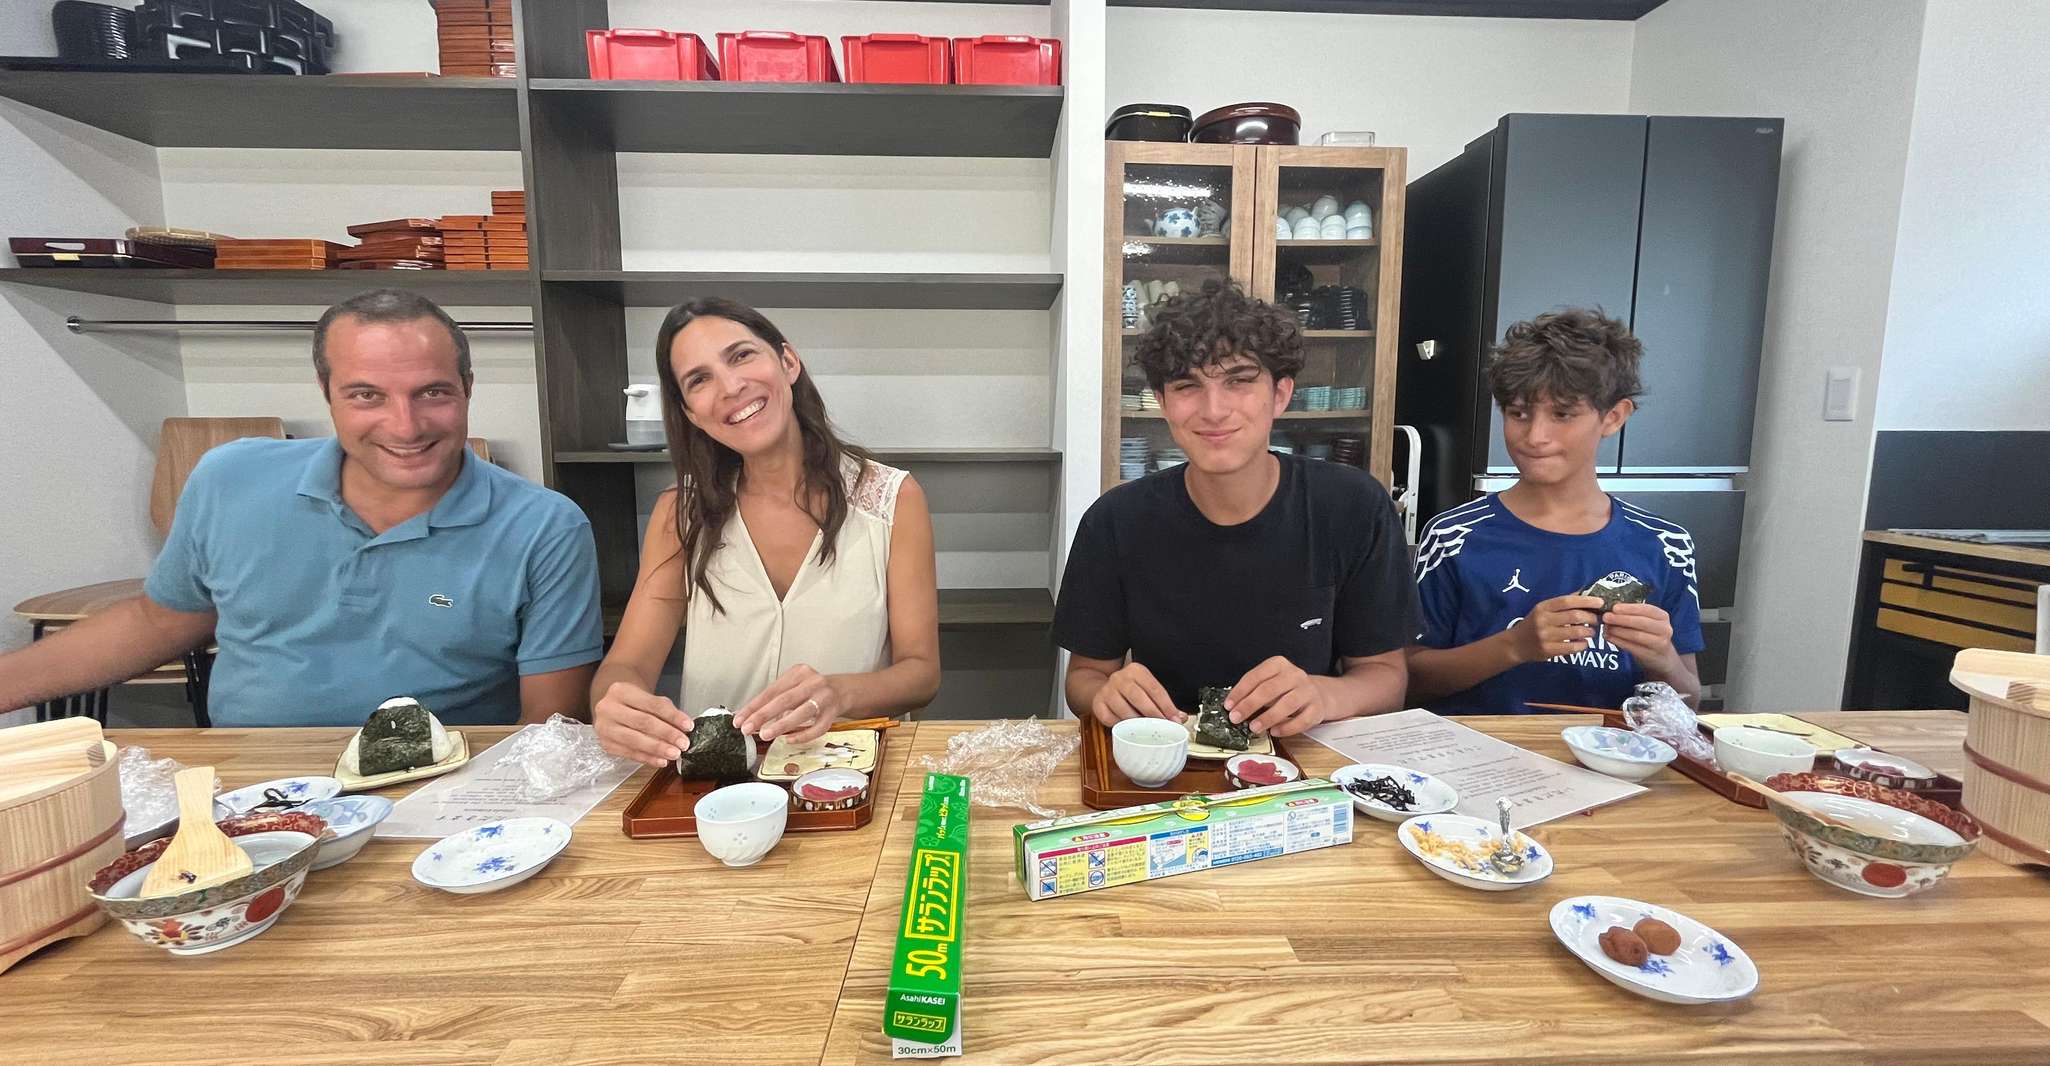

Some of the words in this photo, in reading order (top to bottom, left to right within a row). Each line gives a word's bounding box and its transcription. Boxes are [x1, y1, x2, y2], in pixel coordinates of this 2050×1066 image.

[917, 854, 950, 933] サランラップ
[905, 942, 948, 980] 50m
[897, 1015, 944, 1030] サランラップ
